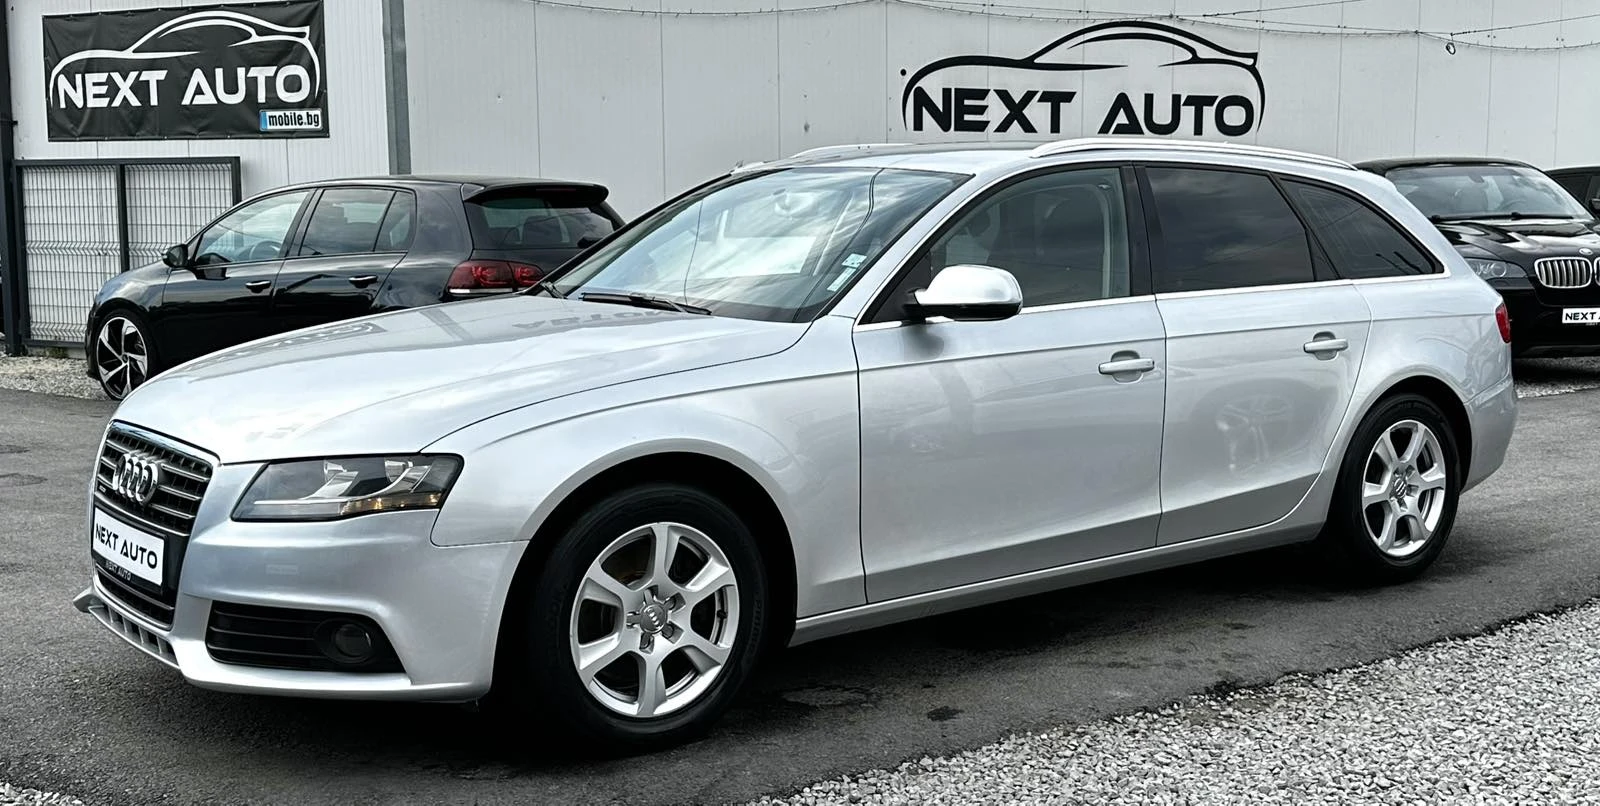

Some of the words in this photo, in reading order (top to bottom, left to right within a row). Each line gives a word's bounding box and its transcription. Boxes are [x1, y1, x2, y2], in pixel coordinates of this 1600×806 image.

[57, 70, 168, 108] NEXT
[181, 64, 311, 105] AUTO
[268, 111, 320, 127] mobile.bg
[913, 86, 1077, 133] NEXT
[1097, 92, 1255, 136] AUTO
[1566, 312, 1597, 321] NEXT
[96, 523, 119, 551] NEXT
[120, 539, 157, 569] AUTO
